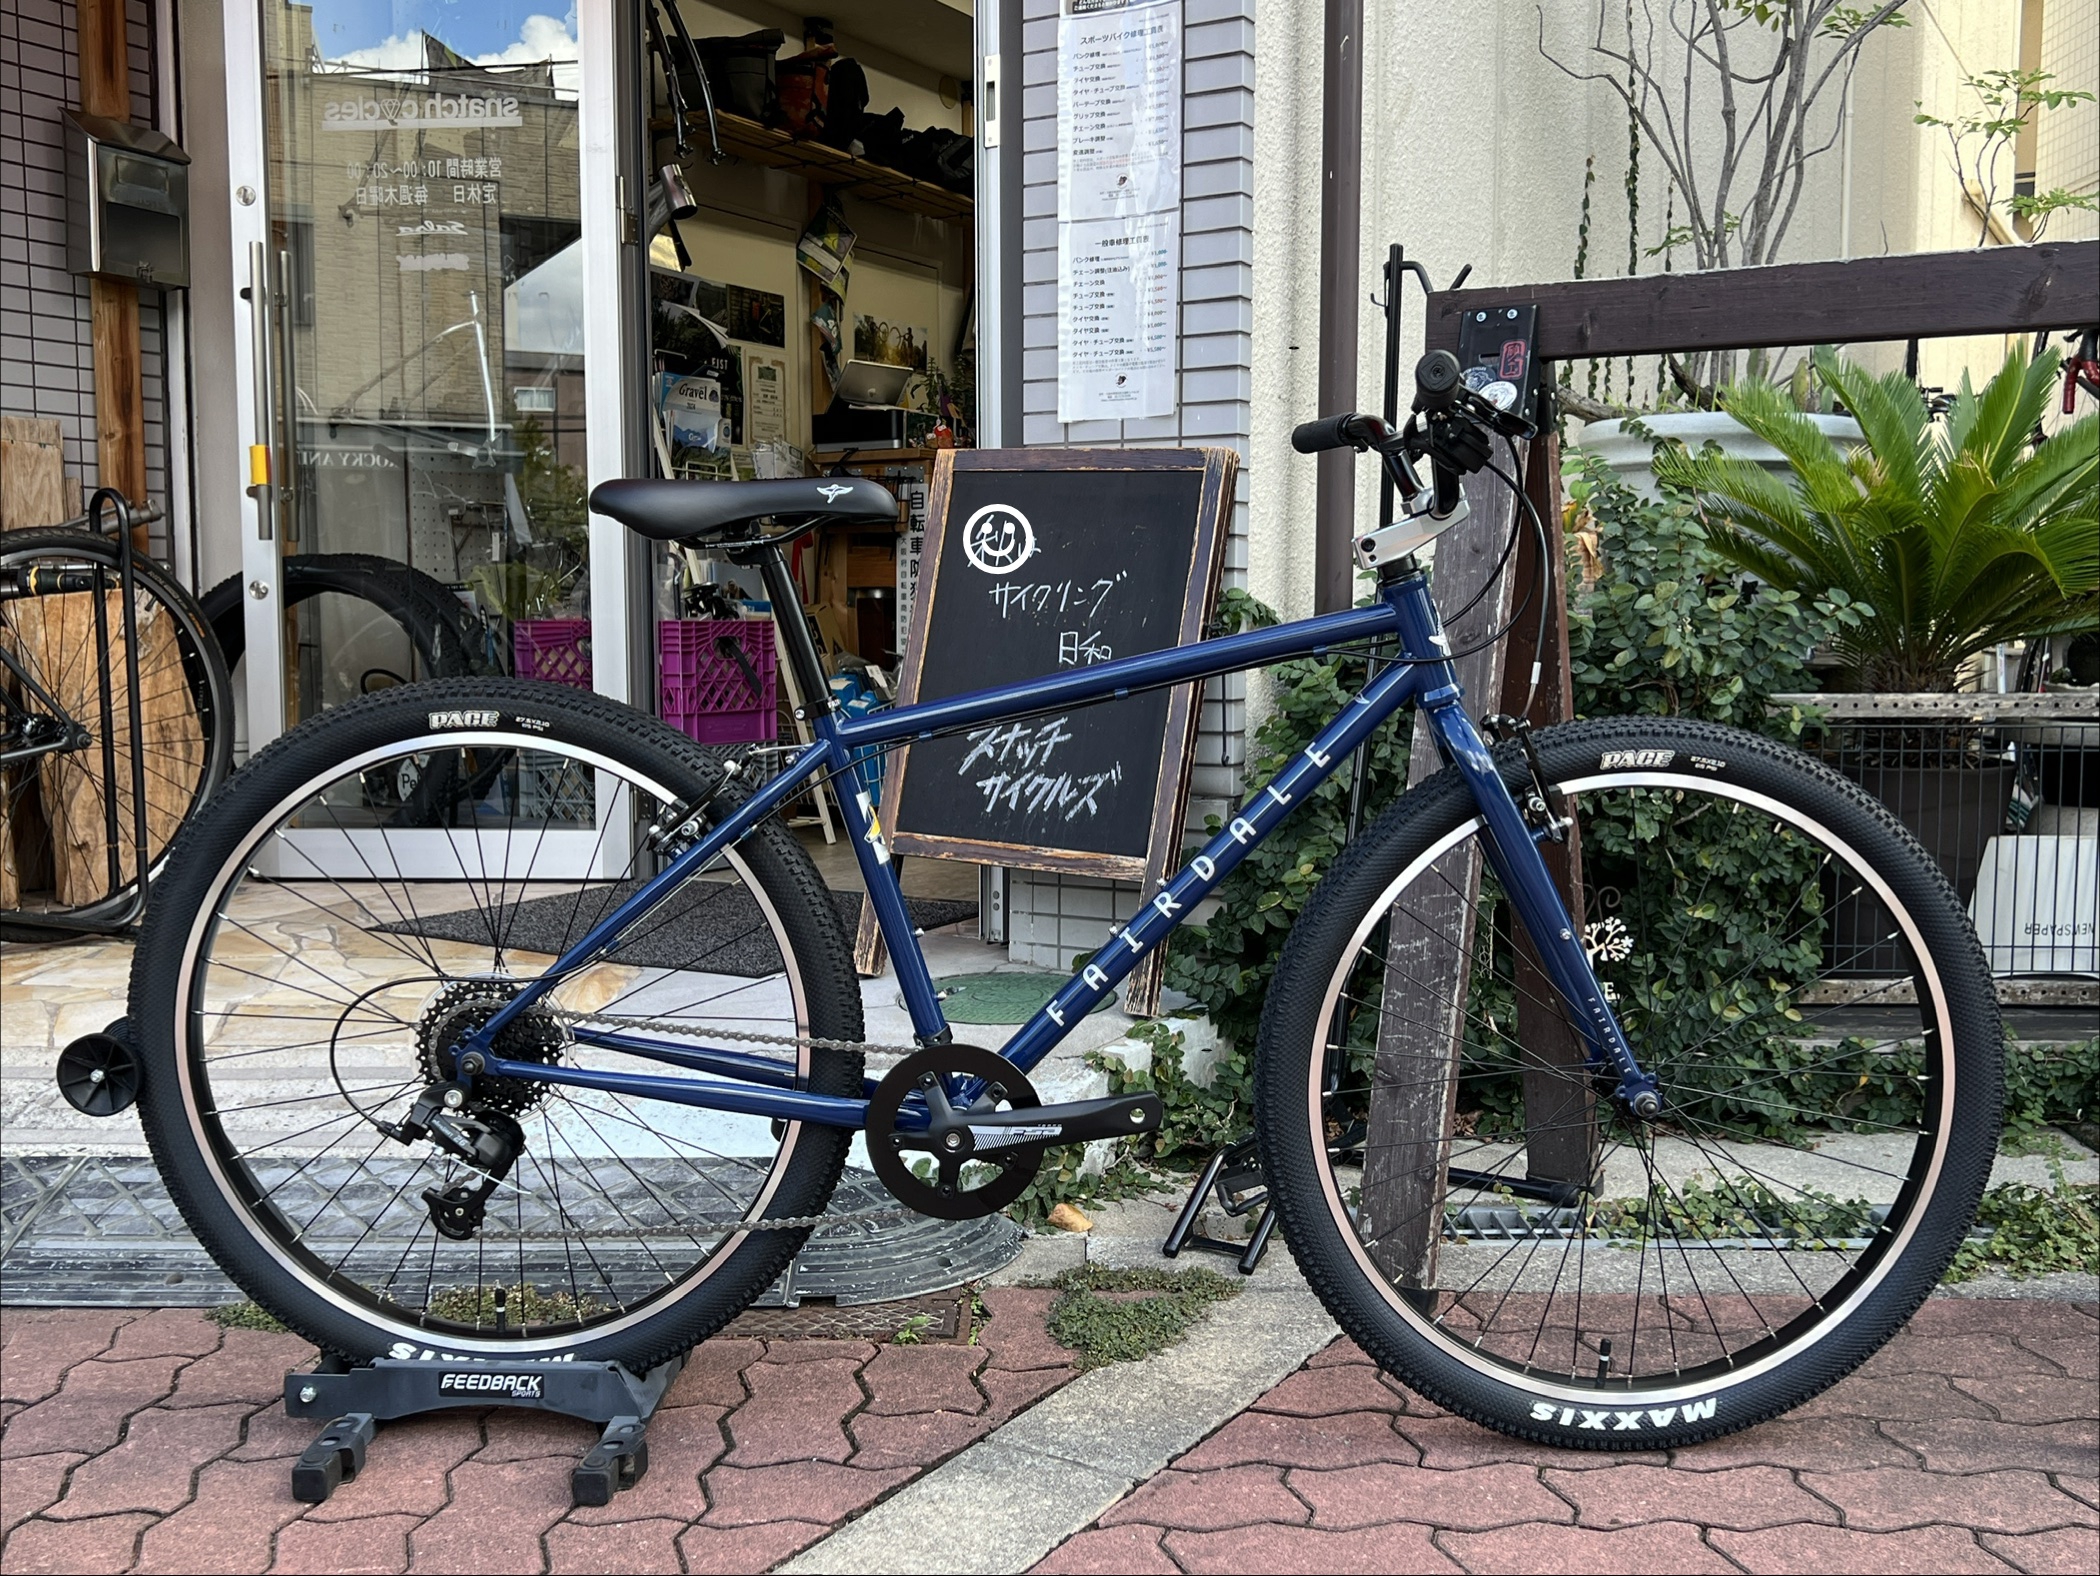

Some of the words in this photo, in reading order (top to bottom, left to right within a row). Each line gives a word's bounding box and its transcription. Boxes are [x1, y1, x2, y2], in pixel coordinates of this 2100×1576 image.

[679, 383, 708, 400] Gravel
[989, 570, 1128, 618] サイクリング
[1058, 631, 1112, 665] 日和
[429, 710, 499, 730] PACE
[958, 716, 1072, 775] スナッチ
[1600, 750, 1675, 770] PACE
[976, 761, 1122, 821] サイクルズ
[1046, 741, 1332, 1027] FAIRDALE
[1587, 997, 1632, 1074] FAIRDALE
[441, 1373, 542, 1392] FEEDBACK
[511, 1389, 541, 1398] SPORTS
[1530, 1397, 1717, 1431] MAXXIS
